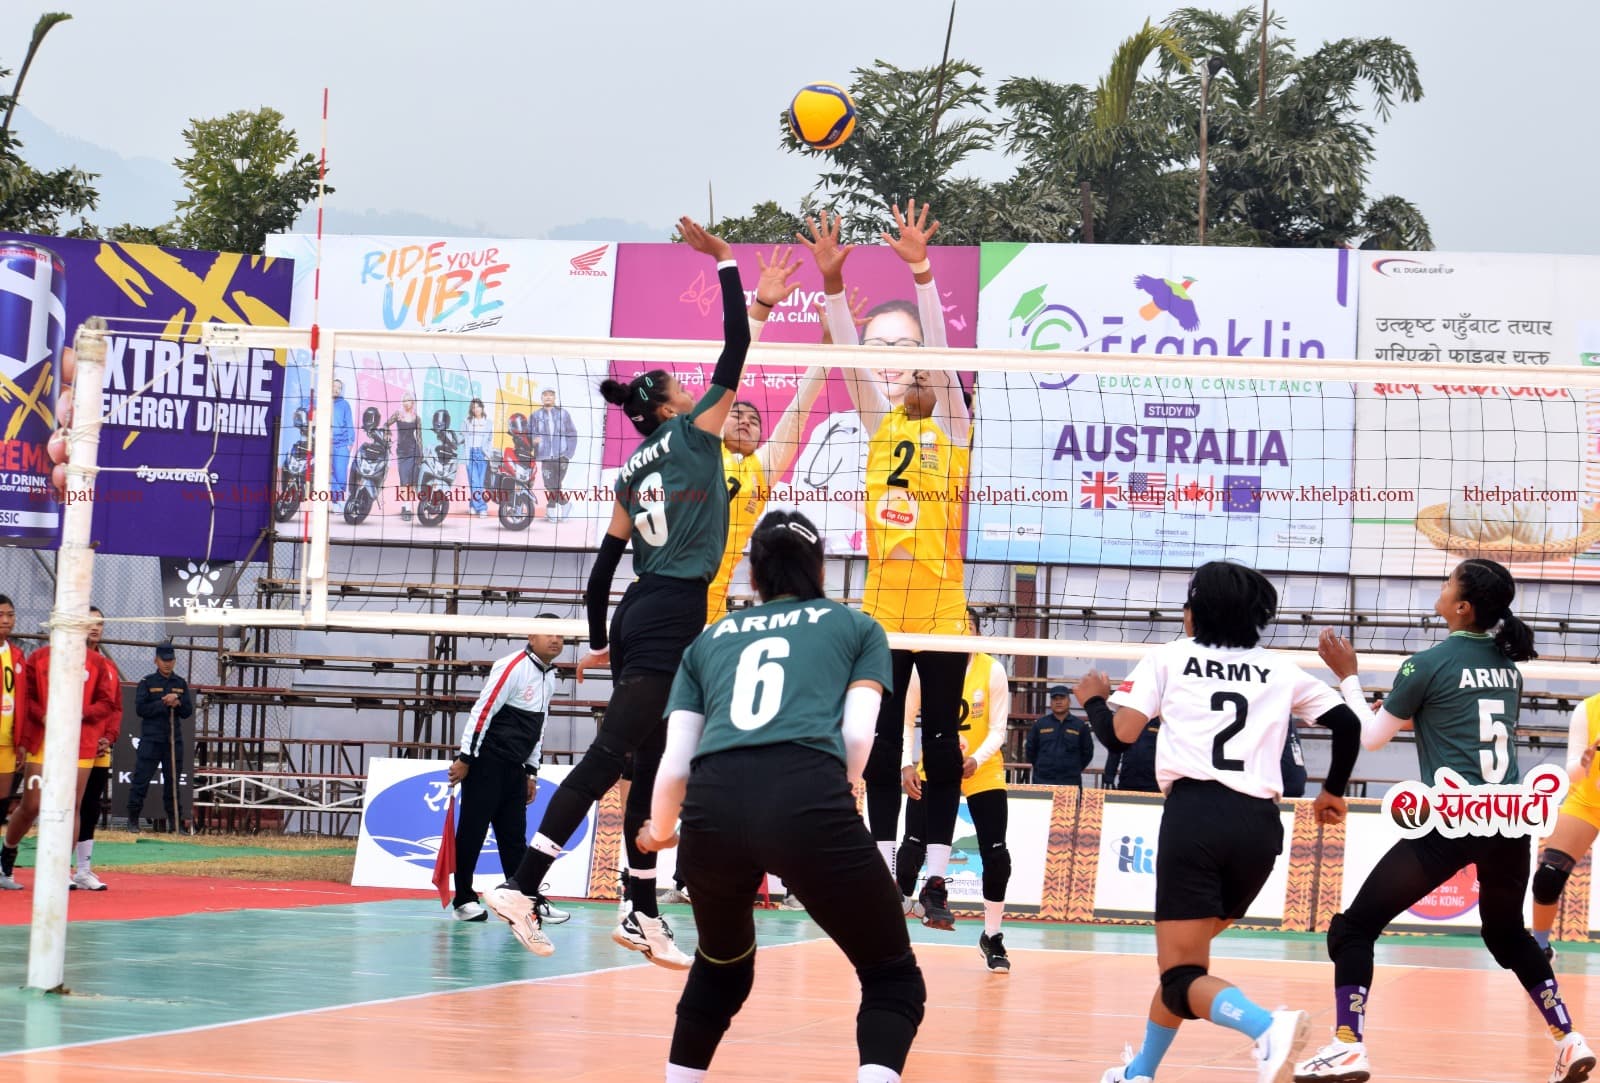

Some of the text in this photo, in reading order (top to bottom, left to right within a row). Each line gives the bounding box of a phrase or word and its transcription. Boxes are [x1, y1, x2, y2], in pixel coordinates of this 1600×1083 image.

[361, 241, 499, 284] RIDE YOUR
[569, 269, 608, 277] HONDA
[382, 264, 510, 331] VIBE
[1101, 317, 1326, 359] Franklin
[1376, 312, 1553, 340] उत्कृष्ट गहुँबाट तयार
[504, 372, 540, 395] LIT
[1099, 375, 1326, 393] EDUCATION CONSULTANCY
[102, 393, 269, 437] ENERGY DRINK
[1148, 406, 1198, 418] STUDY IN
[620, 430, 673, 482] ARMY
[1052, 425, 1290, 467] AUSTRALIA
[886, 440, 916, 488] 2
[12, 475, 47, 487] DRINK
[168, 597, 234, 609] KELME
[712, 606, 833, 639] ARMY
[730, 637, 790, 731] 6
[1182, 656, 1272, 684] ARMY
[1458, 668, 1521, 689] ARMY
[1210, 691, 1249, 772] 2
[1477, 698, 1510, 784] 5
[1440, 896, 1465, 907] KONG
